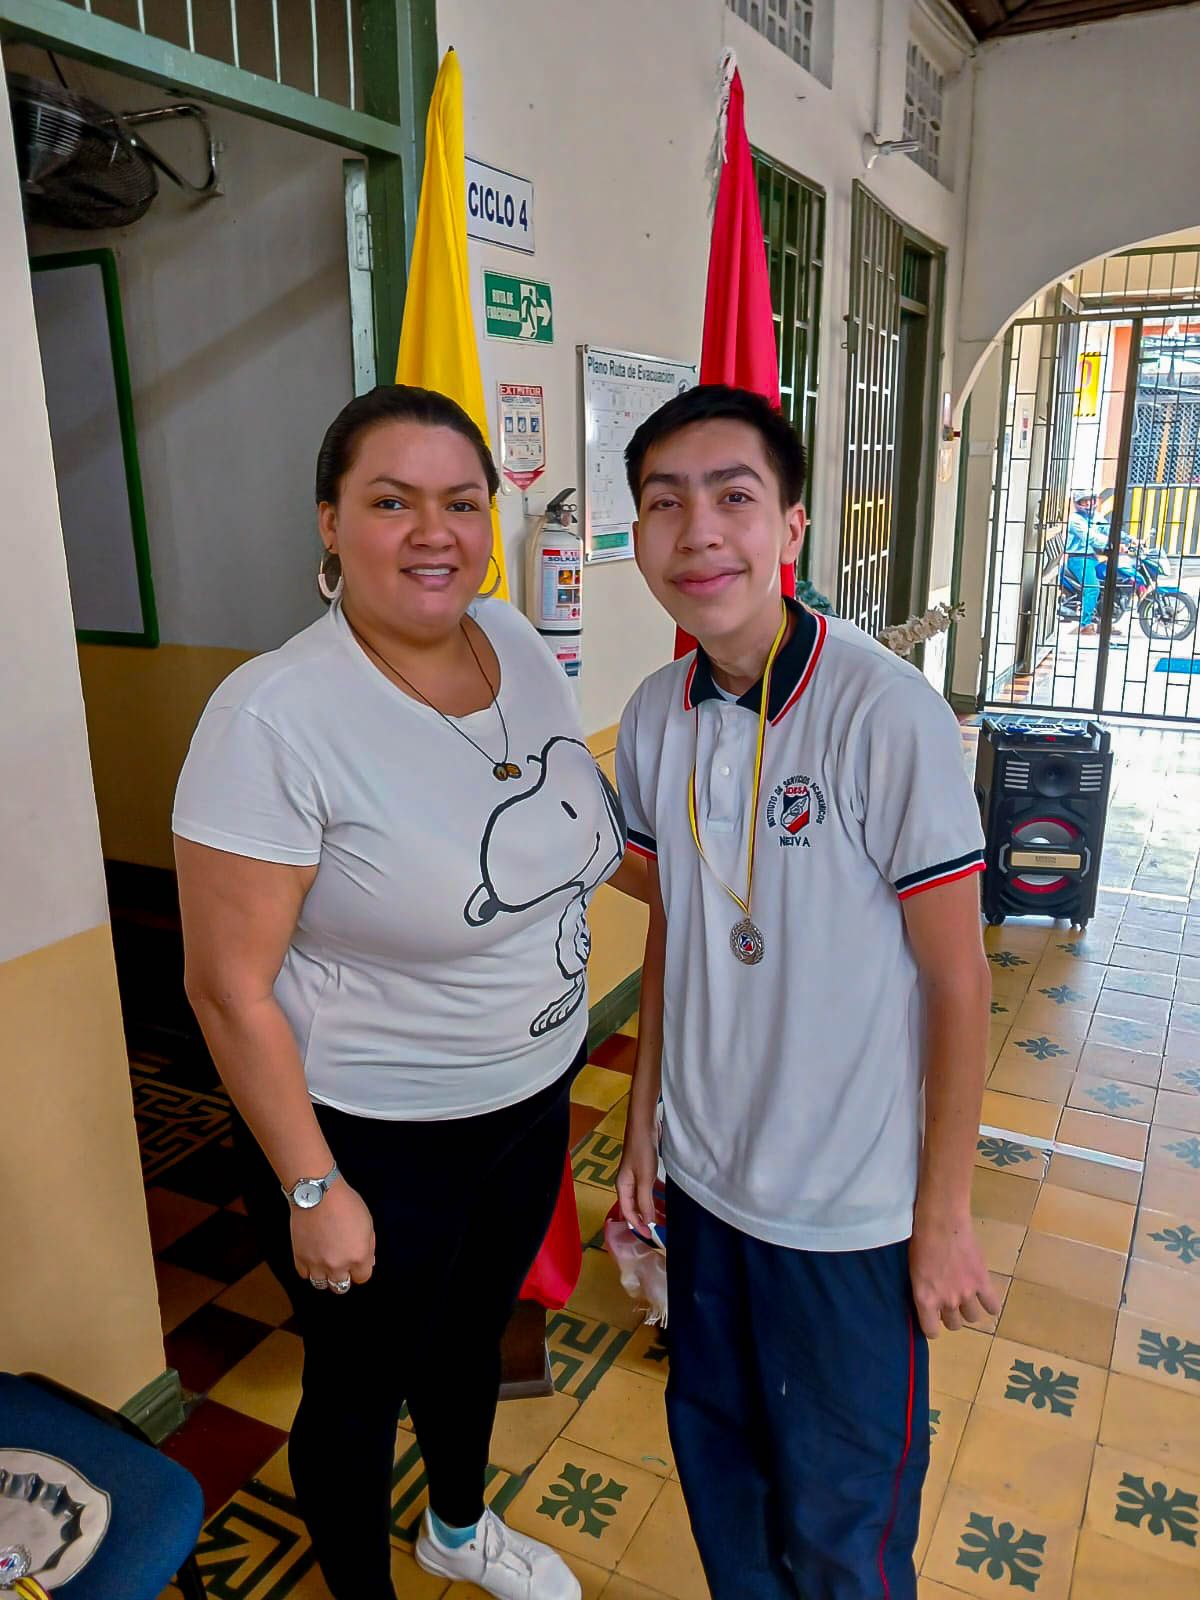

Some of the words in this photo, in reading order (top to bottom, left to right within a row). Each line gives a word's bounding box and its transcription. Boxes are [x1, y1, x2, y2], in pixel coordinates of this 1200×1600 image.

[468, 182, 514, 227] CICLO
[519, 200, 528, 232] 4
[588, 356, 608, 375] Plano
[609, 360, 626, 378] Ruta
[627, 364, 636, 379] de
[779, 836, 811, 848] NEIVA
